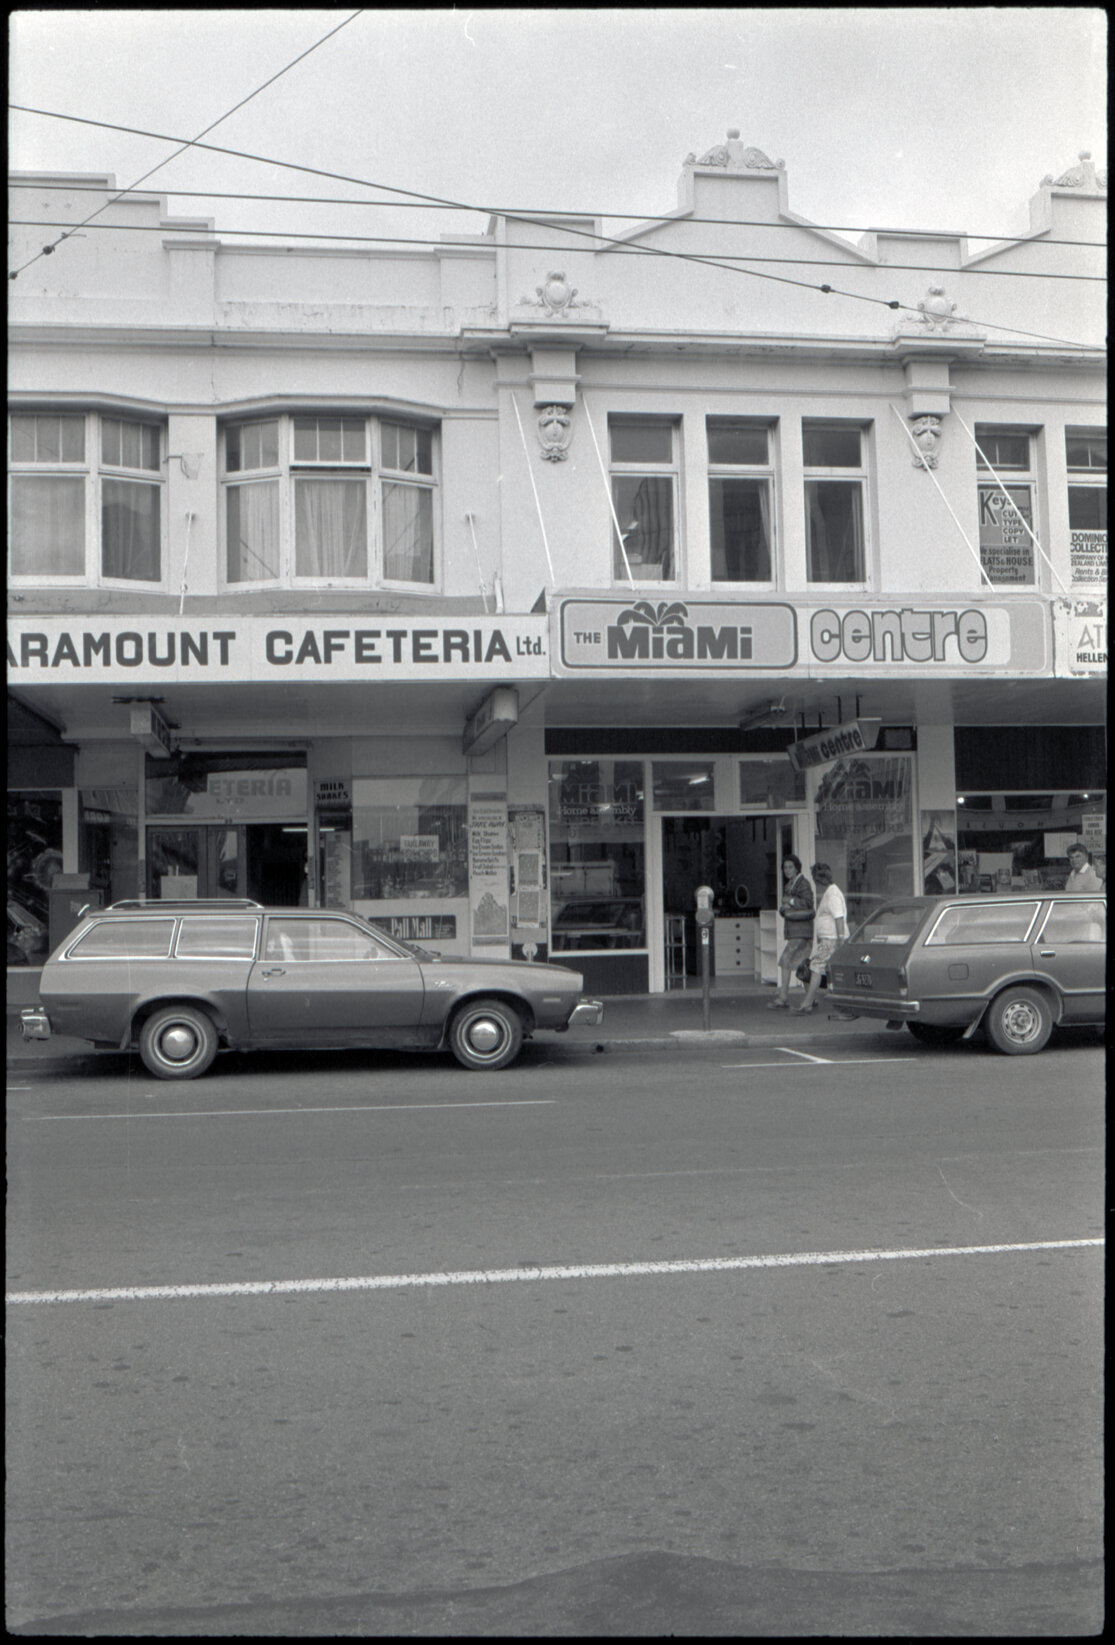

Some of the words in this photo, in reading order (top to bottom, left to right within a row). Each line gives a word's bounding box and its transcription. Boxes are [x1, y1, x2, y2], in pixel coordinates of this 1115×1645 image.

[265, 629, 513, 665] CAFETERIA
[515, 635, 547, 656] Ltd.
[573, 631, 602, 644] THE
[810, 607, 988, 664] centre
[820, 729, 862, 759] centre
[391, 917, 410, 938] Pall
[411, 916, 432, 938] Mall
